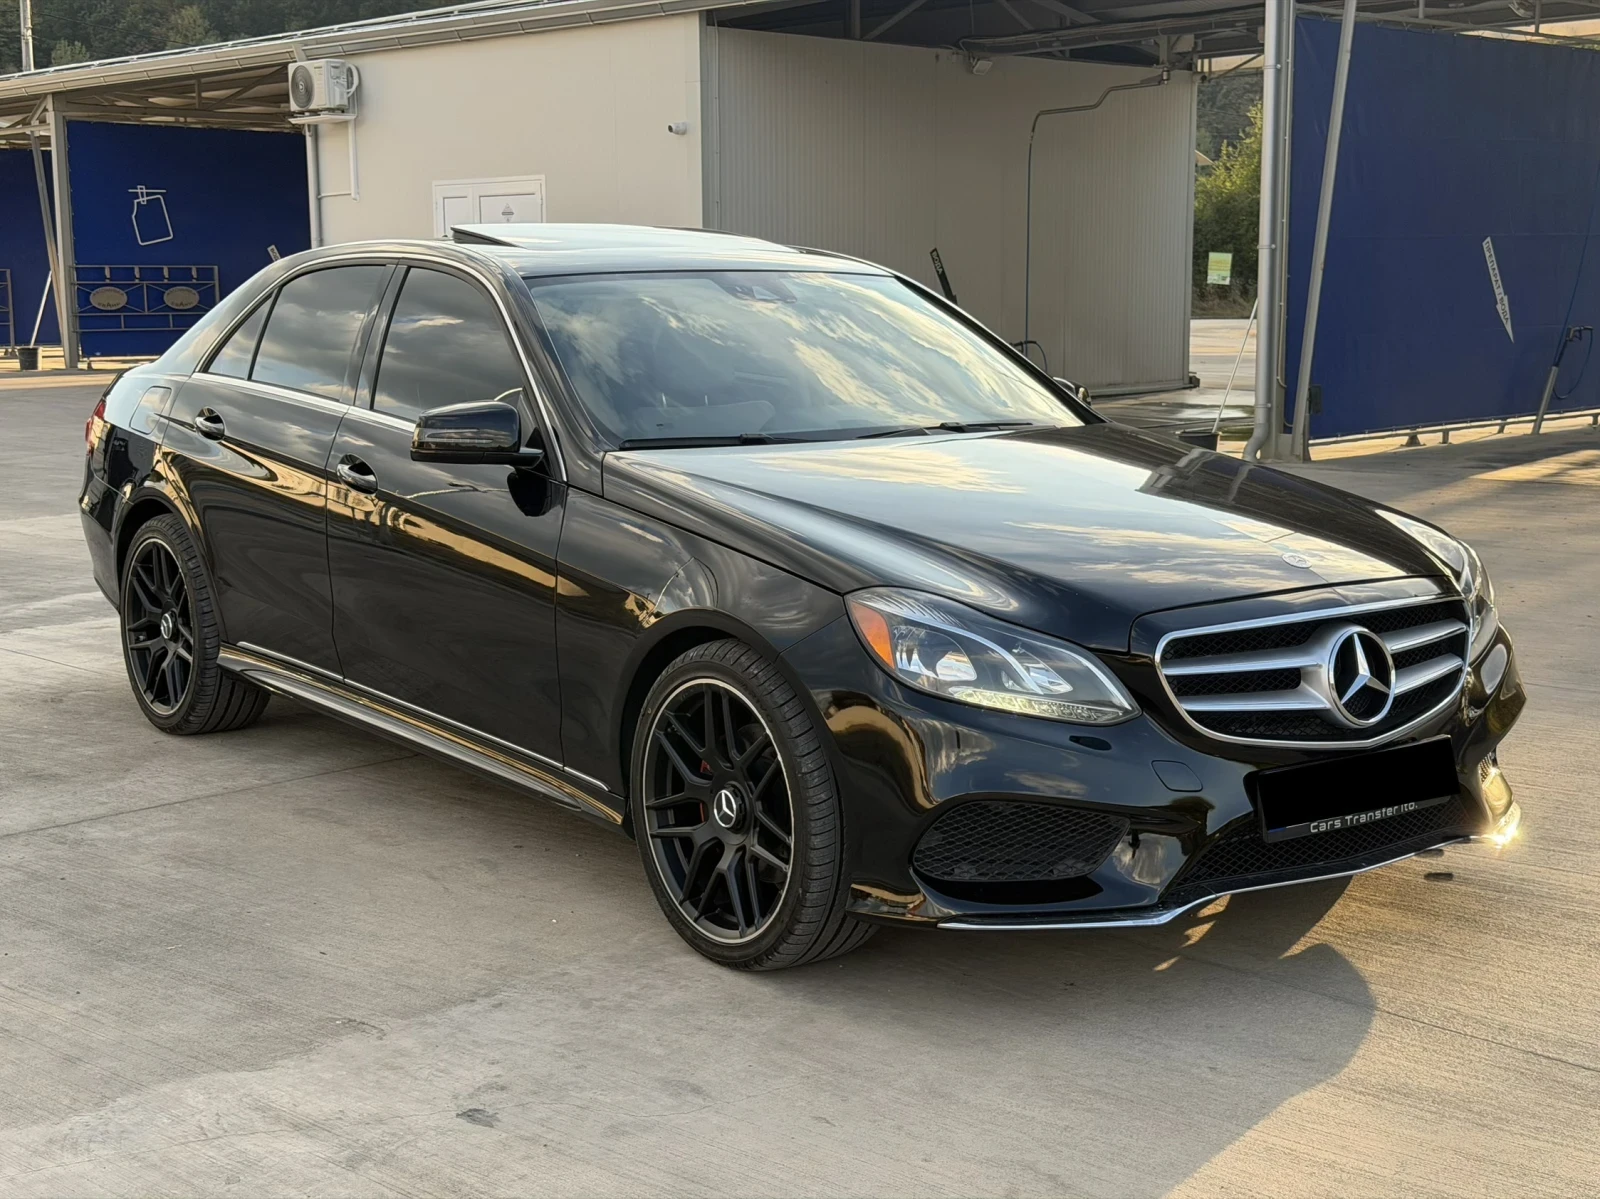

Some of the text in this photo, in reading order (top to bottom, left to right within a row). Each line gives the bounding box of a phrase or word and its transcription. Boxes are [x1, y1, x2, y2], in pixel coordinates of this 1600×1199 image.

[270, 247, 280, 261] ВОД
[931, 250, 943, 275] ВОДА
[1484, 241, 1501, 290] ПРЕПАРАТ
[1499, 296, 1509, 325] ВОДА
[1310, 819, 1341, 833] Cars
[1344, 805, 1399, 826] Transfer
